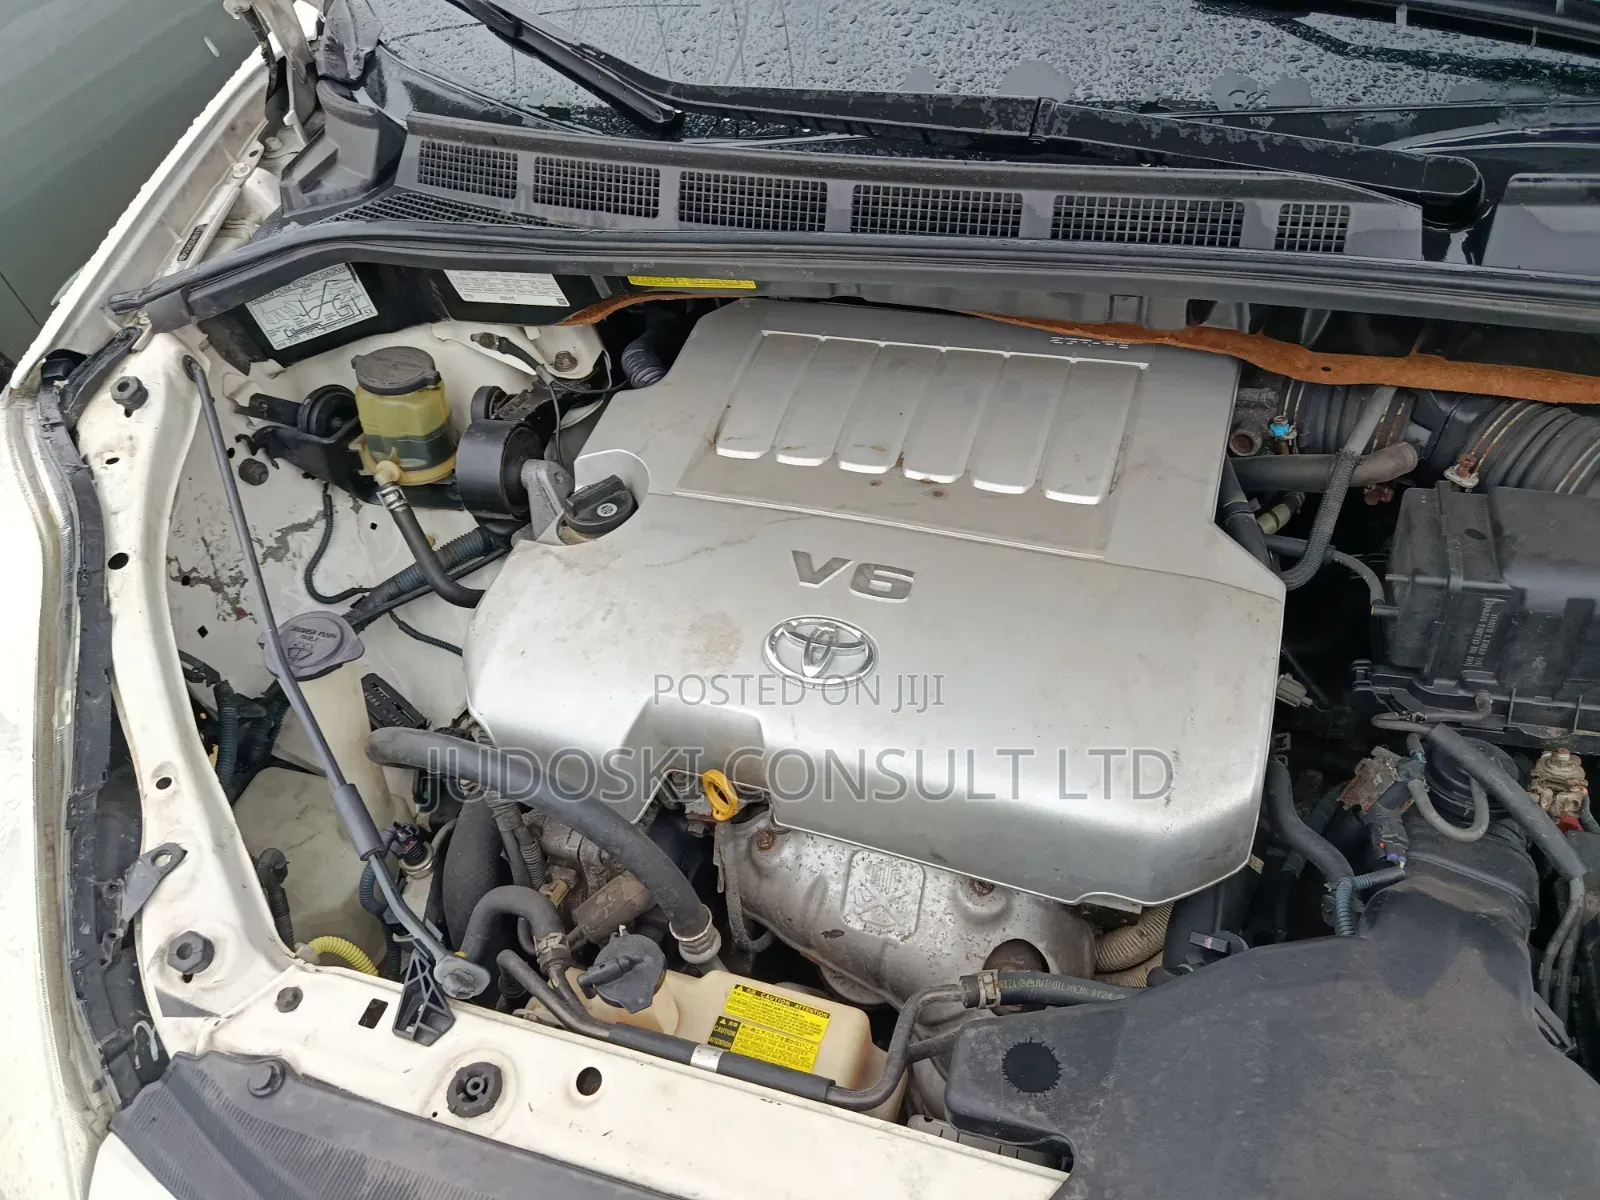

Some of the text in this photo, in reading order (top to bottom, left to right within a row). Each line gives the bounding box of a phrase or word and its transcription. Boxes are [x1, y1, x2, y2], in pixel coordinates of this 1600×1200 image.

[790, 550, 915, 603] V6
[759, 992, 790, 1005] CAUTION
[794, 1003, 828, 1018] ATTENTION
[713, 1024, 736, 1037] CAUTION
[708, 1036, 731, 1048] ATTENTION
